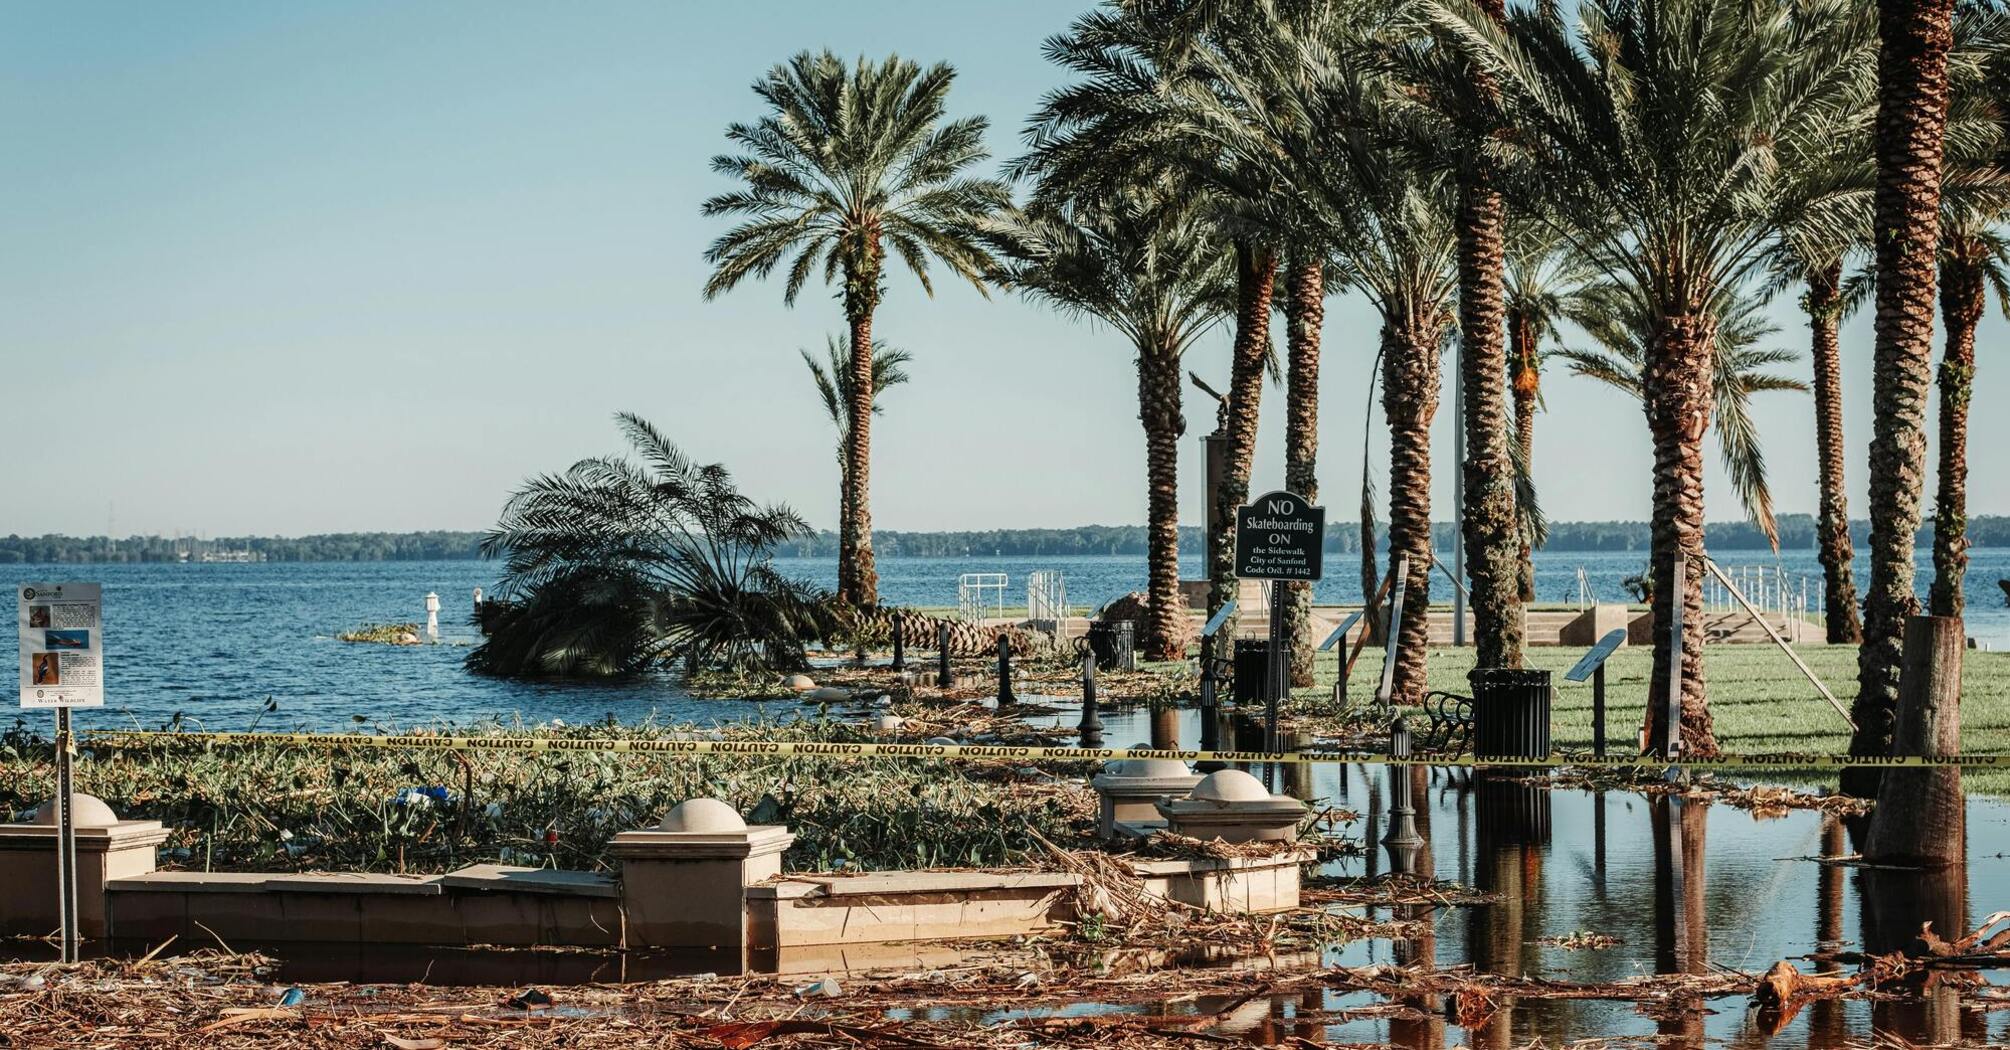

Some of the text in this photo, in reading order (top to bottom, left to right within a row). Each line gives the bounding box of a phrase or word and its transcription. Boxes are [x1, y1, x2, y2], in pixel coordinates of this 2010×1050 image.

[1268, 500, 1294, 515] NO
[1247, 517, 1314, 534] Skateboarding
[1269, 533, 1291, 545] ON
[1268, 547, 1305, 555] Sidewalk
[1251, 556, 1265, 565] City
[1245, 566, 1265, 574] Code
[308, 736, 373, 745] CAUTION
[387, 738, 453, 747] CAUTION
[467, 739, 533, 749] CAUTION
[548, 740, 615, 750] CAUTION
[629, 741, 697, 751] CAUTION
[711, 743, 779, 753] CAUTION
[793, 744, 862, 754] CAUTION
[876, 745, 945, 755] CAUTION
[959, 747, 1029, 756] CAUTION
[1044, 748, 1113, 757] CAUTION
[1127, 750, 1198, 758] CAUTION
[1386, 754, 1460, 762] CAUTION
[1743, 756, 1817, 764] CAUTION
[1832, 756, 1906, 764] CAUTION
[1921, 756, 1996, 764] CAUTION
